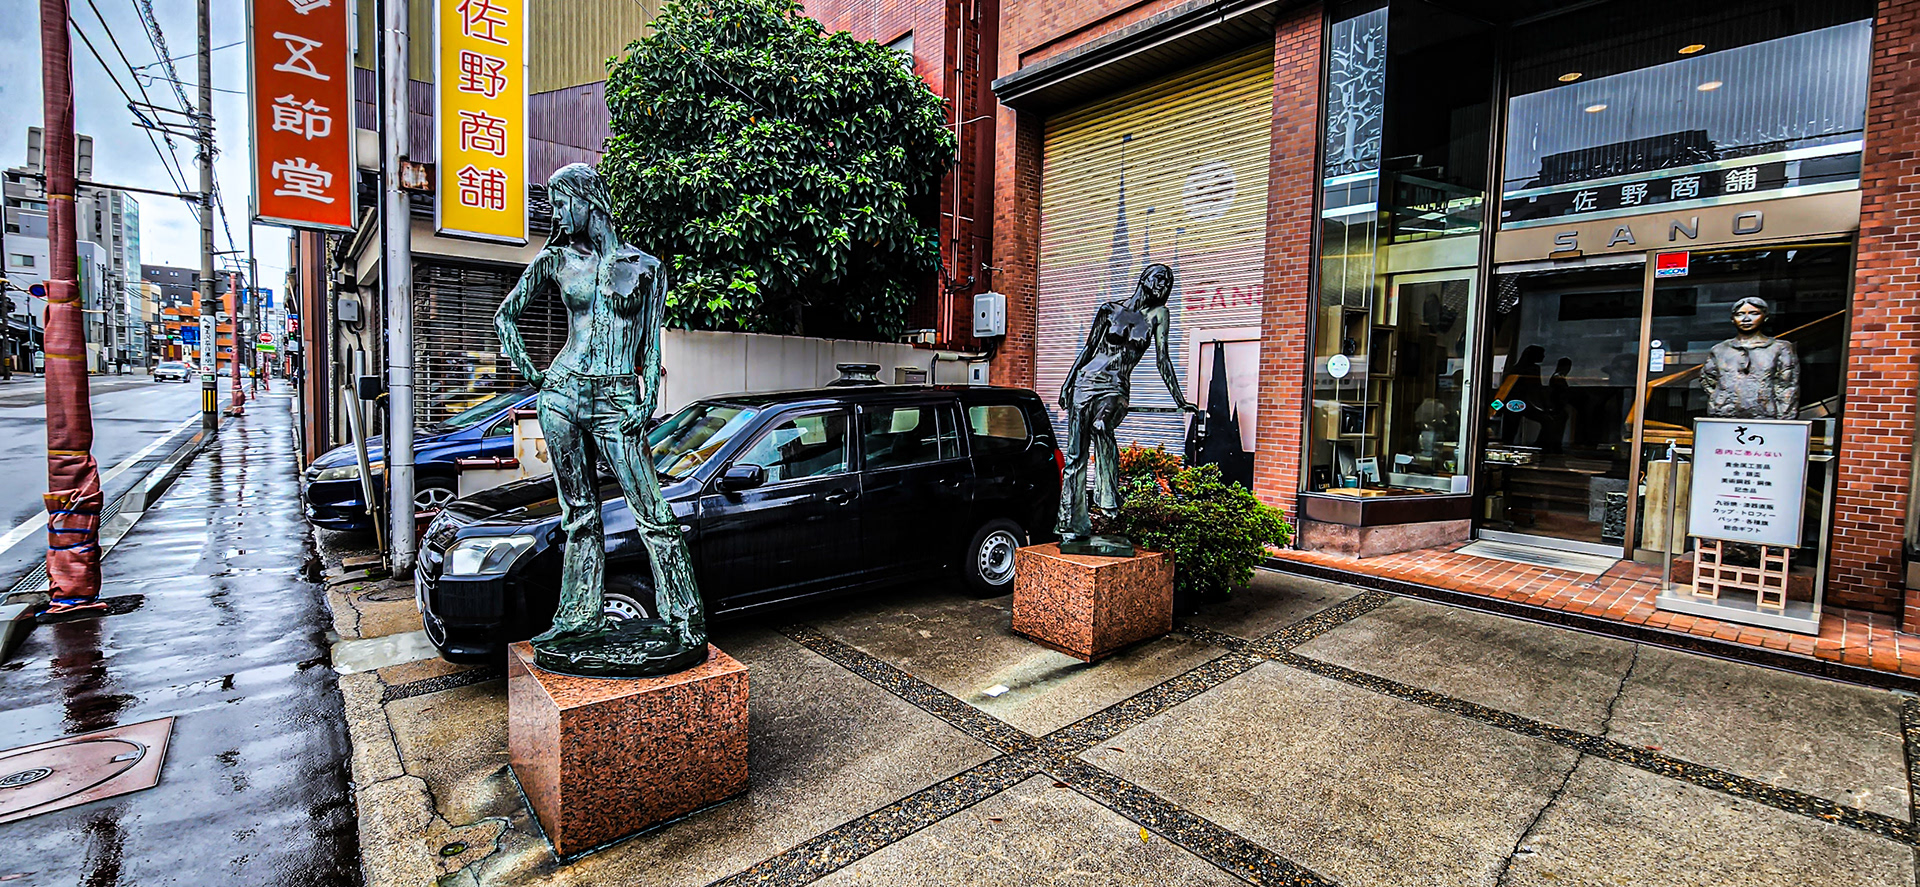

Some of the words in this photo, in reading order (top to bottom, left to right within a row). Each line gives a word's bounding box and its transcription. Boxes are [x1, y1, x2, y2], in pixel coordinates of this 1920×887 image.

[271, 31, 335, 204] 五節堂
[456, 0, 510, 211] 佐野商舗
[1572, 167, 1758, 212] 佐野商舗
[1554, 210, 1764, 251] SANO
[1657, 267, 1687, 276] SECOM
[1714, 448, 1783, 458] 店内ごあんない
[1734, 426, 1765, 446] さの
